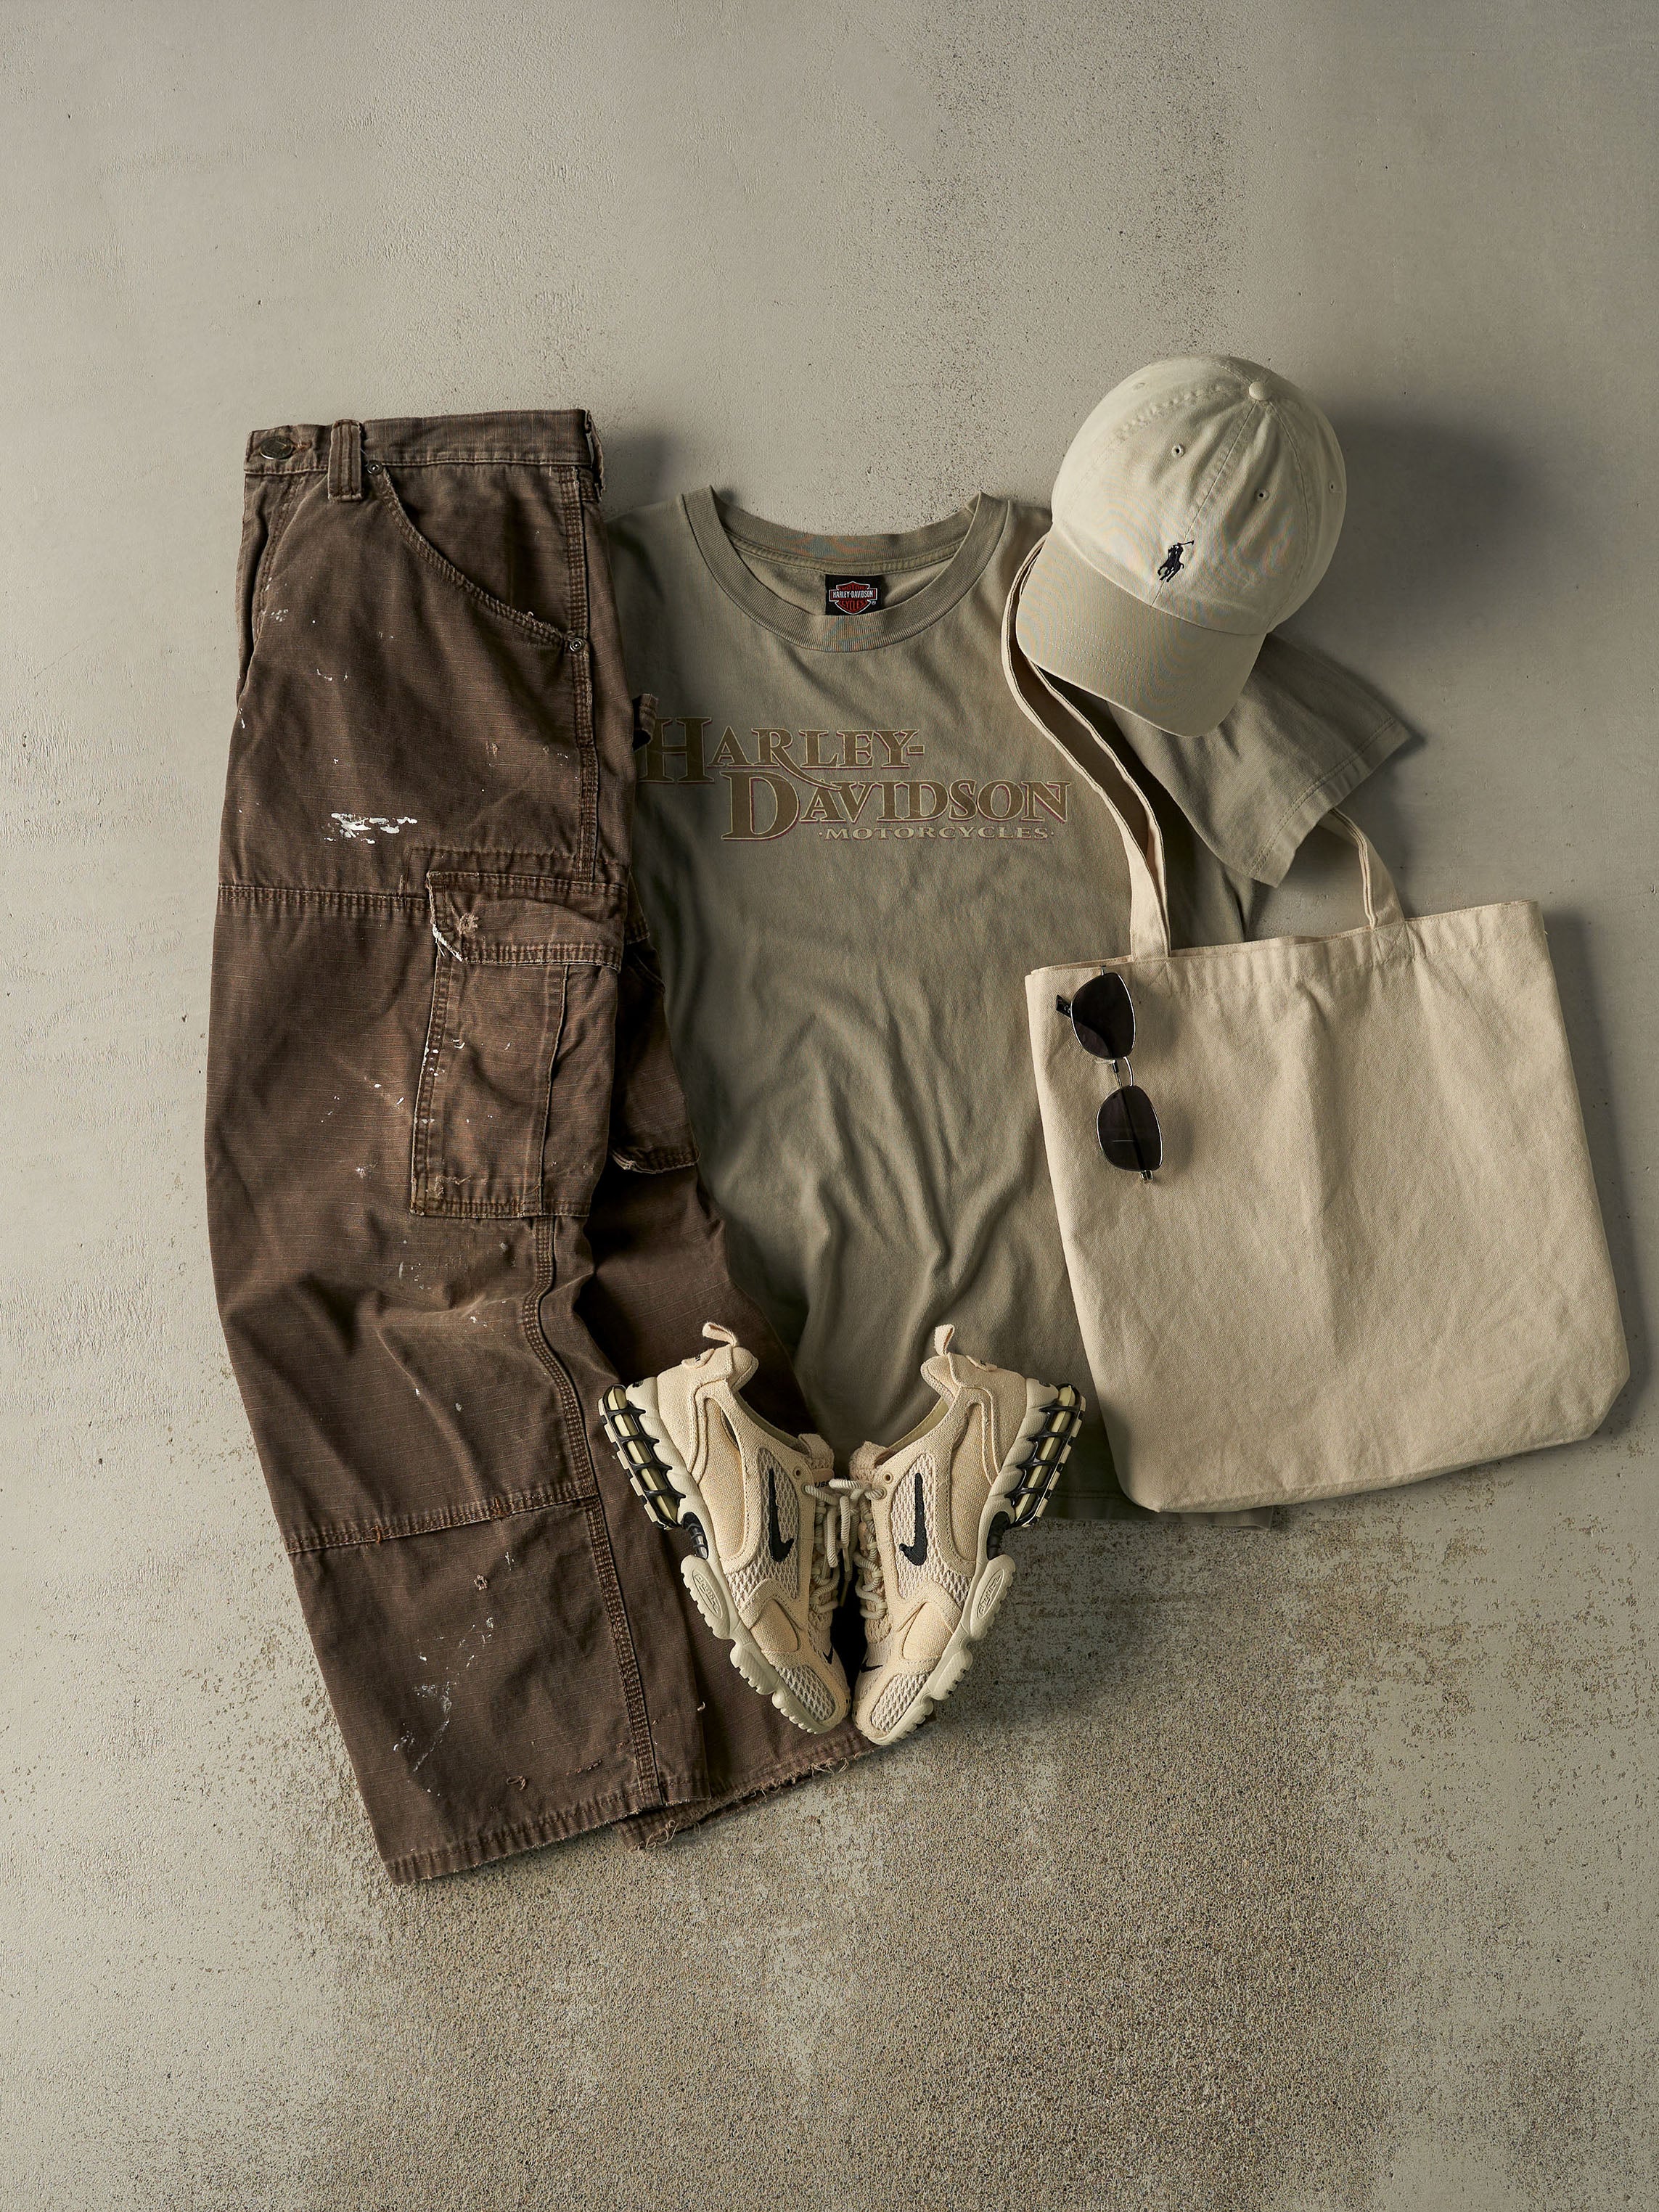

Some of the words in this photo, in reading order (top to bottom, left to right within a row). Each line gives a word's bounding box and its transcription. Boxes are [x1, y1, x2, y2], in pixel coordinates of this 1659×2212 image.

[842, 600, 864, 611] CYCLES
[638, 717, 926, 791] HARLEY-
[720, 770, 1070, 840] DAVIDSON
[824, 827, 1049, 840] MOTORCYCLES
